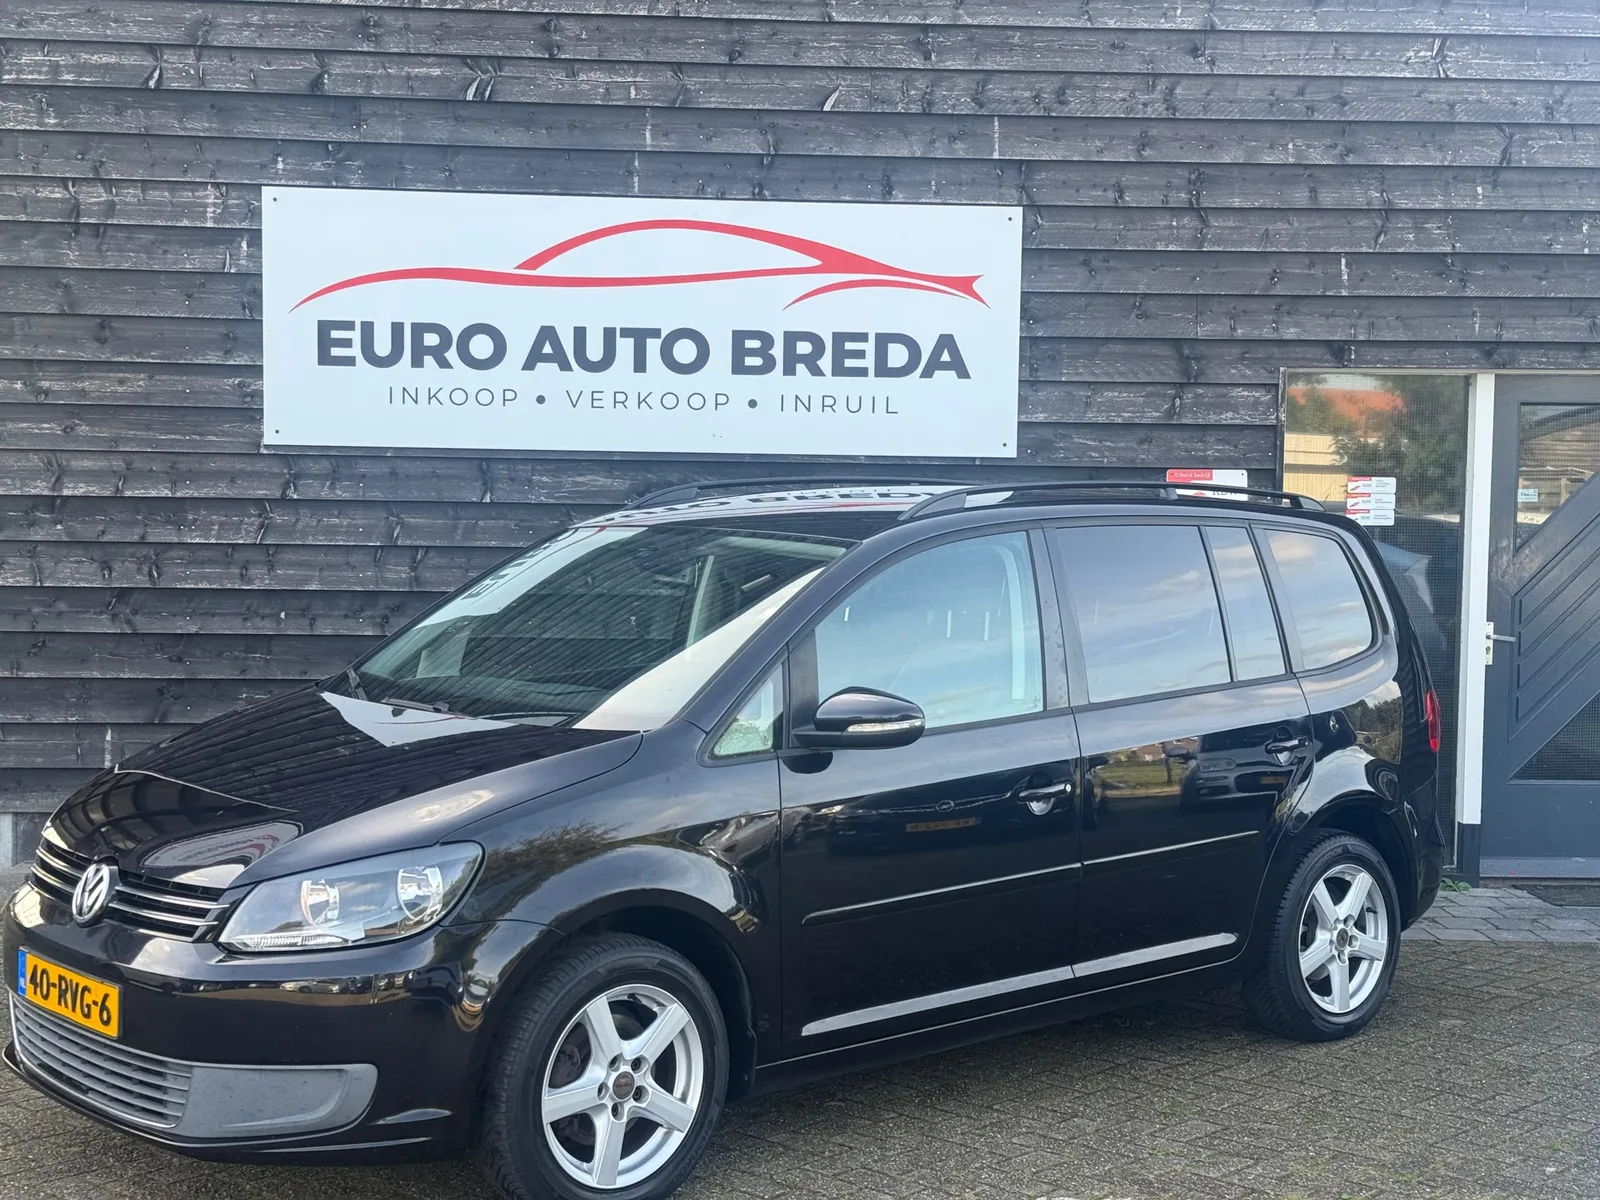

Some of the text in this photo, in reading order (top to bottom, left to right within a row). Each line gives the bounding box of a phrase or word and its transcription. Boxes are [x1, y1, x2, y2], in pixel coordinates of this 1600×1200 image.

[317, 319, 971, 379] EURO AUTO BREDA
[389, 386, 899, 414] INKOOP VERKOOP INRUIL
[28, 964, 112, 1027] 40-RVG-6
